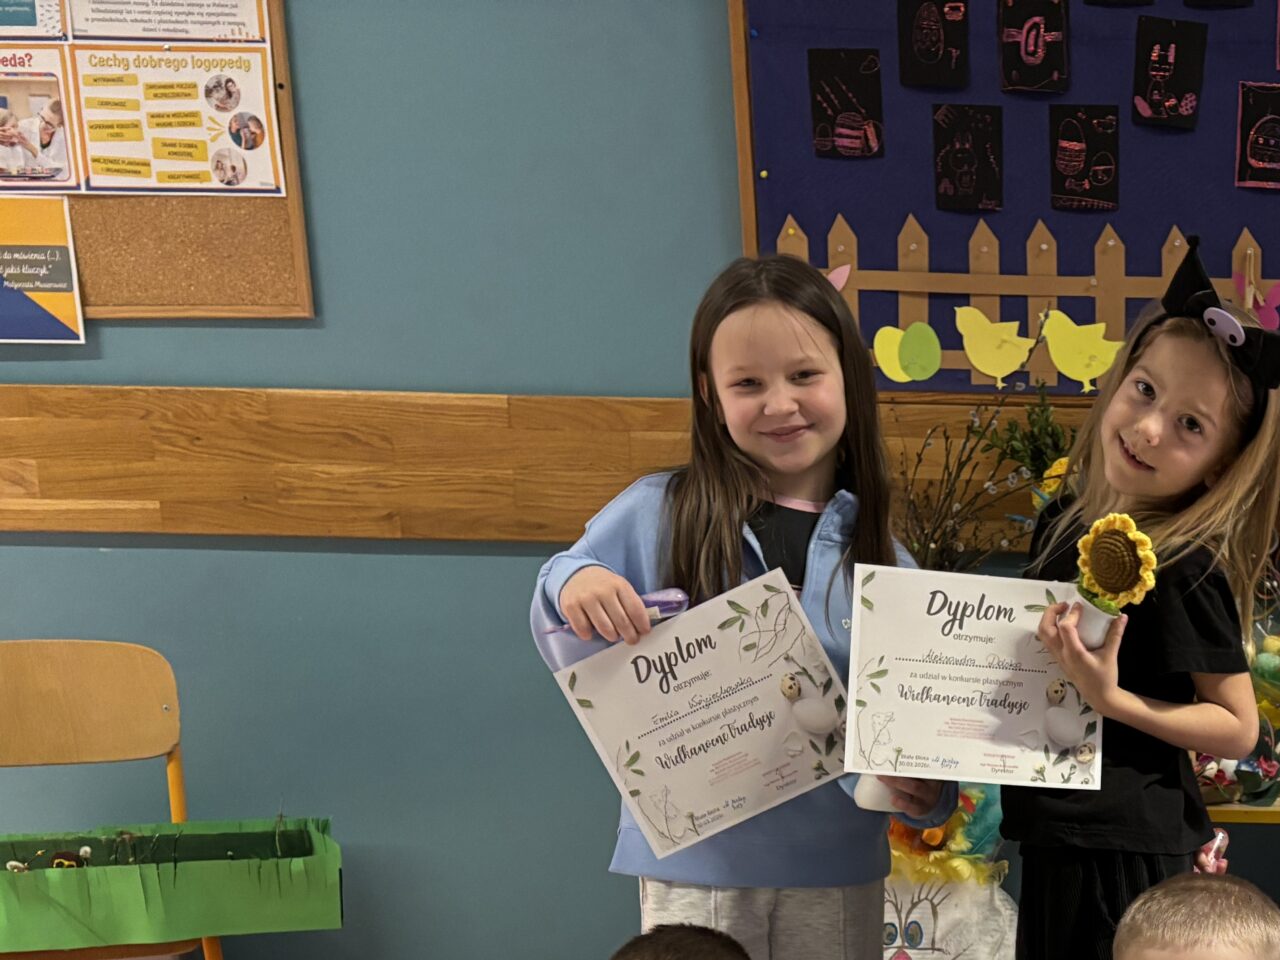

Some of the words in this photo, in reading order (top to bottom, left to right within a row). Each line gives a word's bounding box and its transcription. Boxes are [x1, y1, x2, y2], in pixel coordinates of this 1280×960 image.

[0, 53, 33, 68] eda?
[88, 54, 130, 71] Cechy
[133, 55, 188, 71] dobrego
[191, 55, 252, 72] logopedy
[926, 590, 1015, 637] Dyplom
[952, 633, 995, 644] otrzymuje:
[630, 634, 716, 694] Dyplom
[673, 670, 712, 692] otrzymuje:
[919, 671, 940, 680] udział
[948, 673, 981, 684] konkursie
[982, 677, 1023, 688] plastycznym
[898, 683, 978, 707] Wielkanocne
[971, 690, 1029, 715] Tradycje
[655, 731, 729, 769] Wielkanocne
[720, 711, 775, 742] Tradycje
